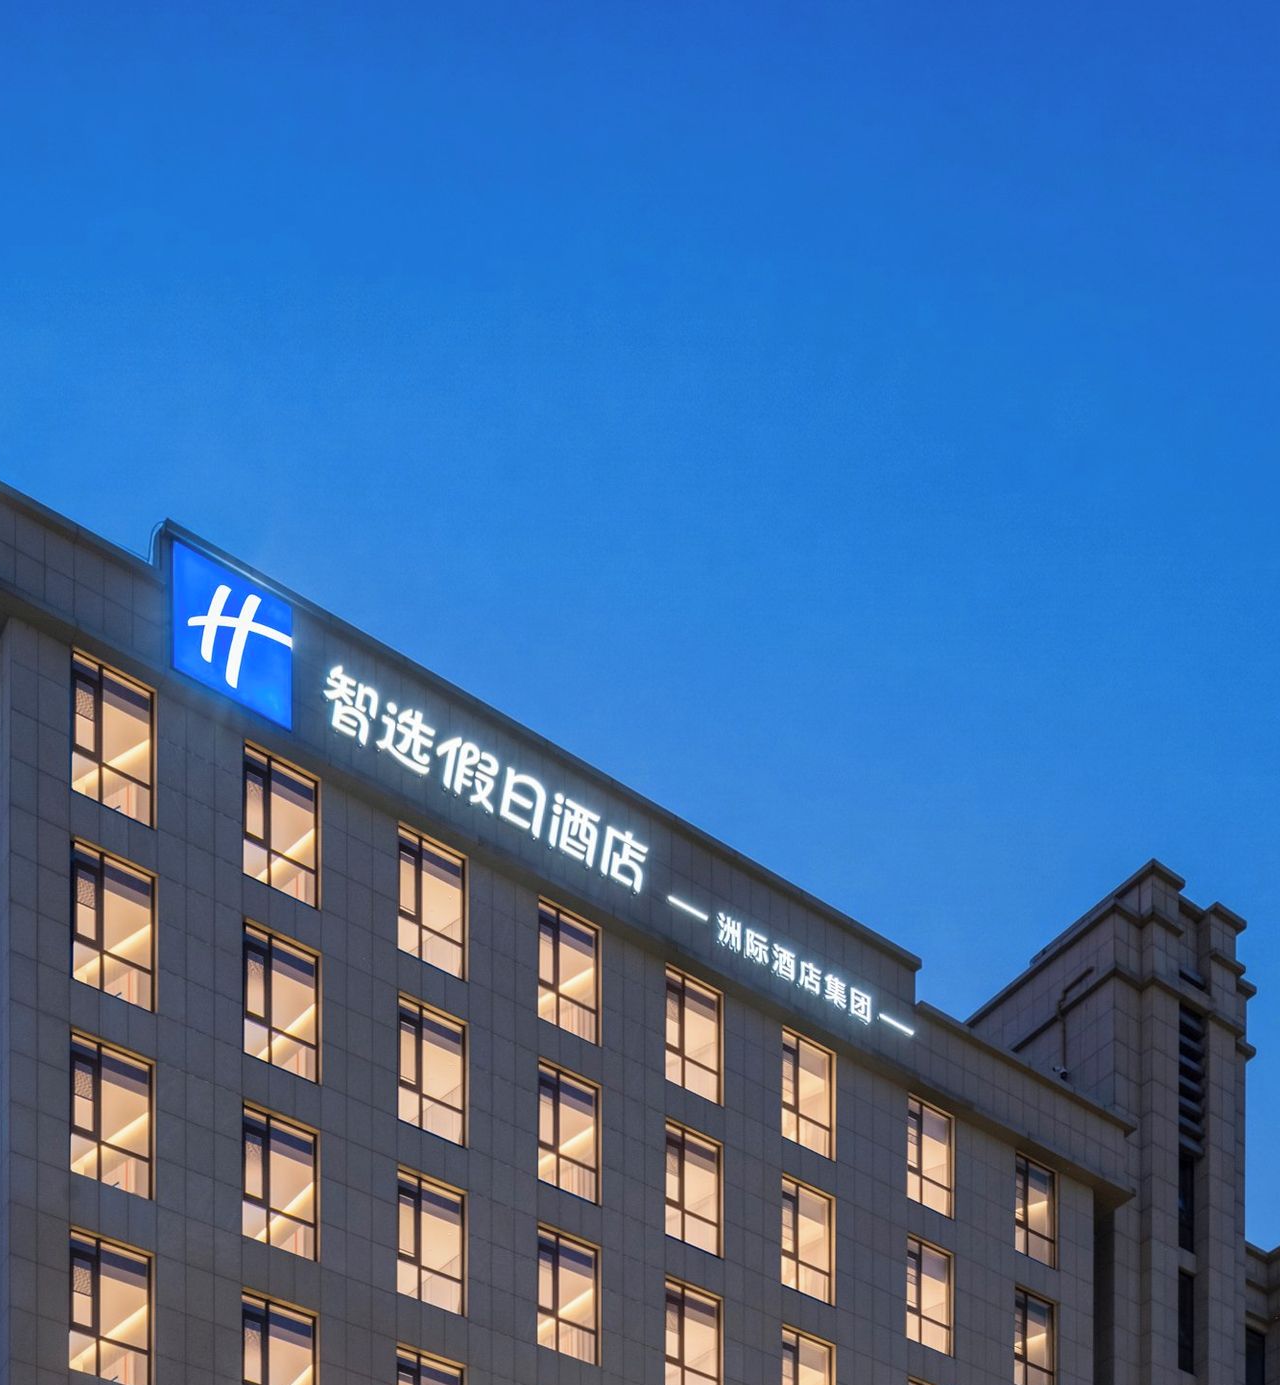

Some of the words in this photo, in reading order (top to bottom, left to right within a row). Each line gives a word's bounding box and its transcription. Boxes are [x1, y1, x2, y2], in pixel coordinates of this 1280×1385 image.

[323, 664, 650, 894] 智选假日酒店
[715, 911, 873, 1024] 洲际酒店集团
